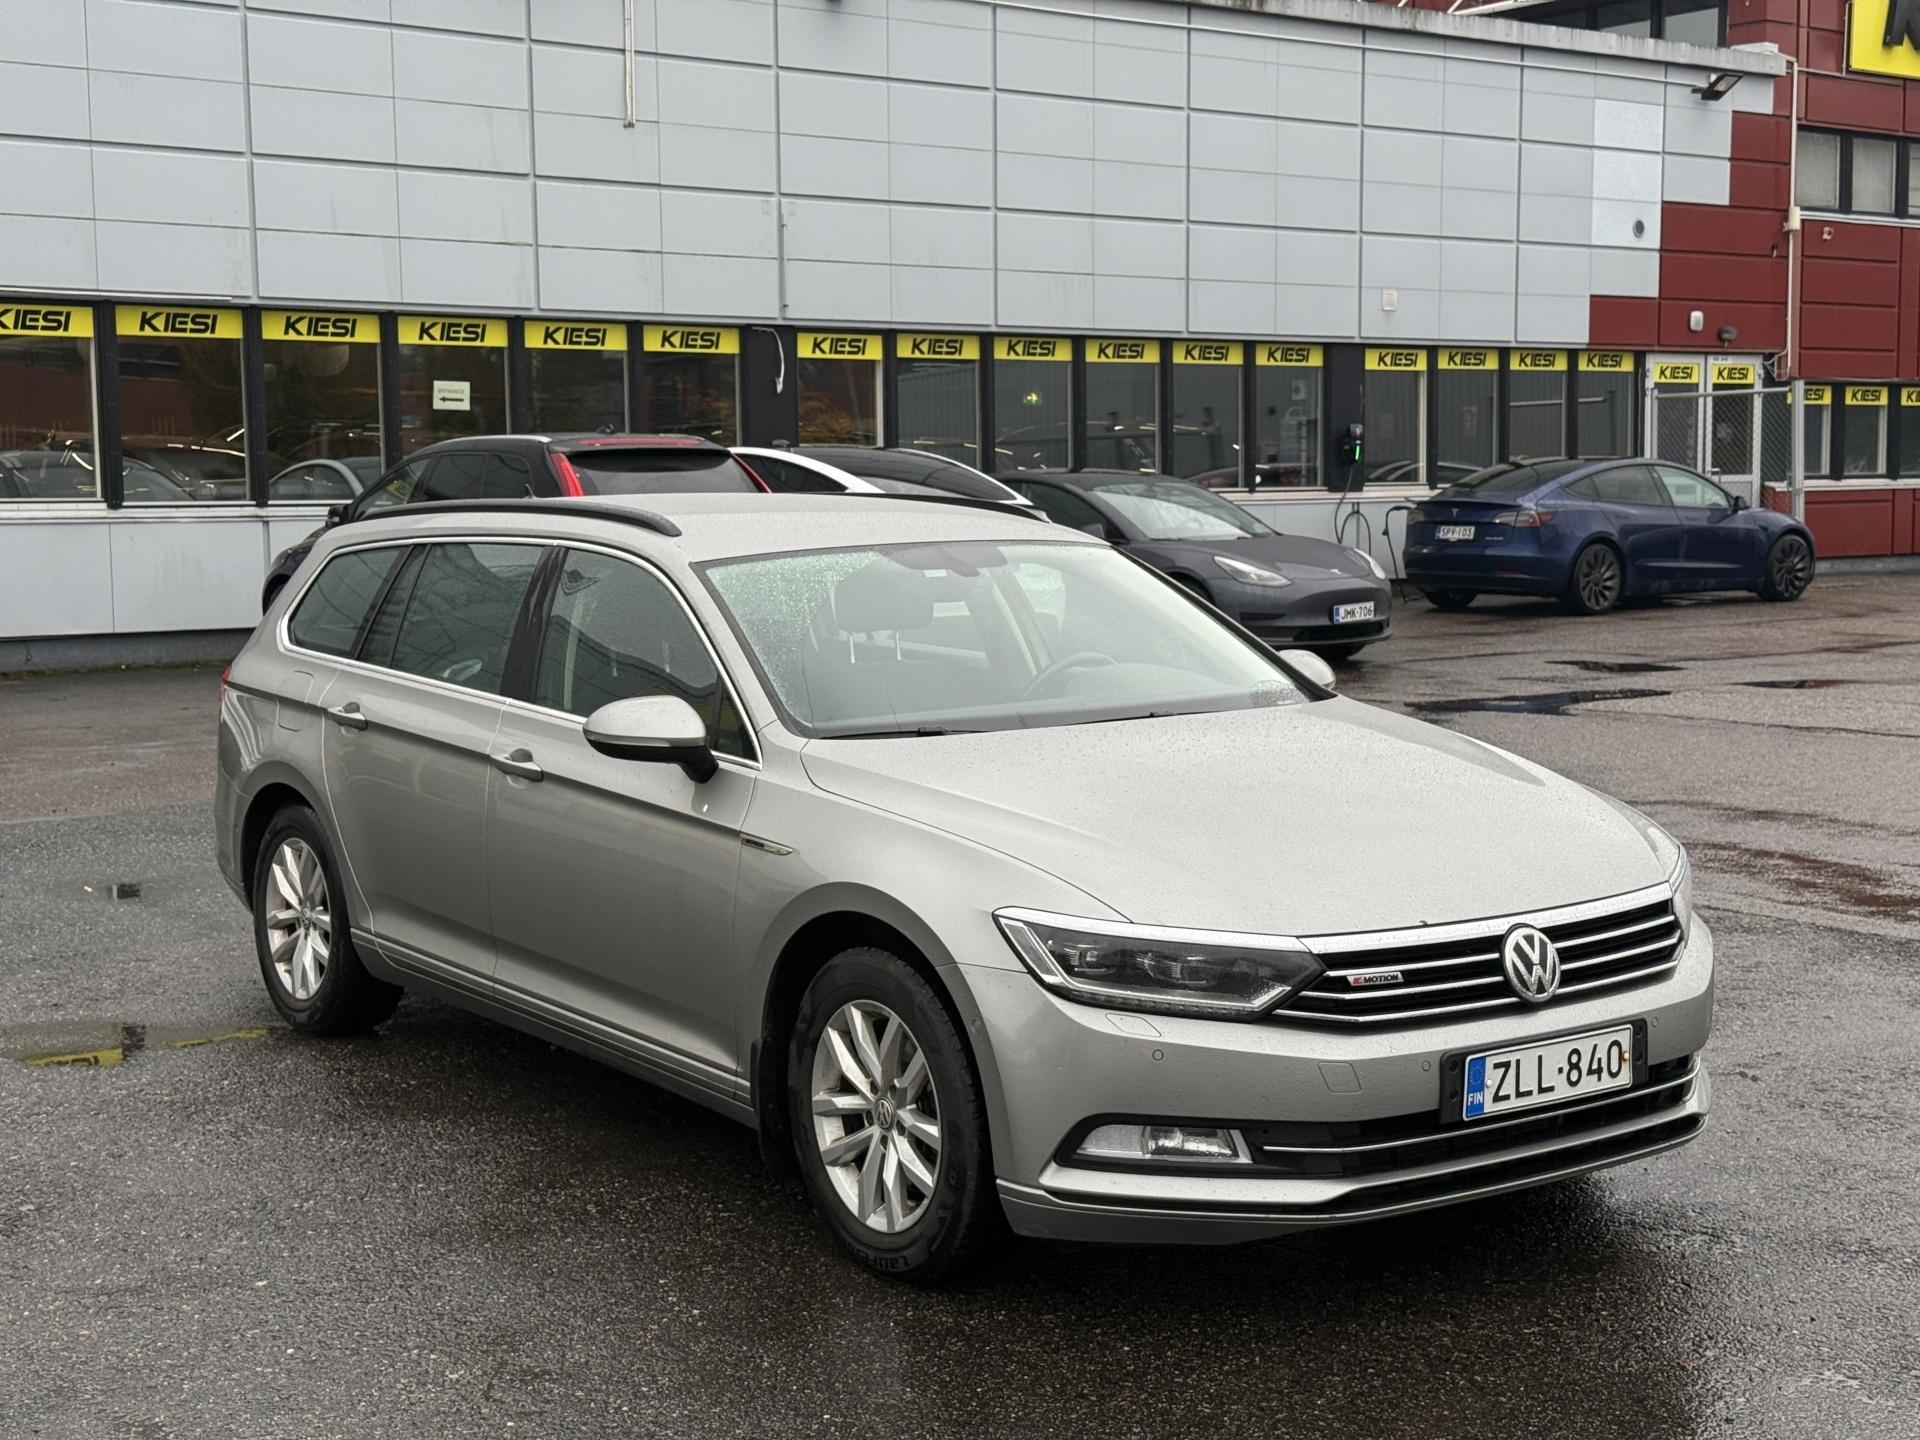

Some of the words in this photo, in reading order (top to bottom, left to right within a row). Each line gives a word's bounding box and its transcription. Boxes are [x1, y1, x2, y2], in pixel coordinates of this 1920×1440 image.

[139, 311, 218, 334] KIESI
[283, 316, 357, 338] KIESI
[418, 321, 487, 343] KIESI
[543, 326, 608, 347] KIESI
[661, 330, 721, 350] KIESI
[812, 337, 867, 356] KIESI
[911, 337, 964, 356] KIESI
[1007, 339, 1056, 358] KIESI
[1097, 342, 1144, 360] KIESI
[1184, 345, 1230, 362] KIESI
[1267, 346, 1310, 363] KIESI
[1377, 351, 1418, 367] KIESI
[1448, 351, 1487, 367] KIESI
[1519, 353, 1556, 368] KIESI
[1586, 353, 1623, 368] KIESI
[1659, 366, 1693, 380] KIESI
[1717, 367, 1750, 381] KIESI
[1804, 388, 1825, 402] ESI
[1851, 388, 1882, 402] KIESI
[1341, 605, 1373, 620] JMK-706
[1492, 1039, 1623, 1103] ZLL-840
[1467, 1091, 1484, 1106] FIN
